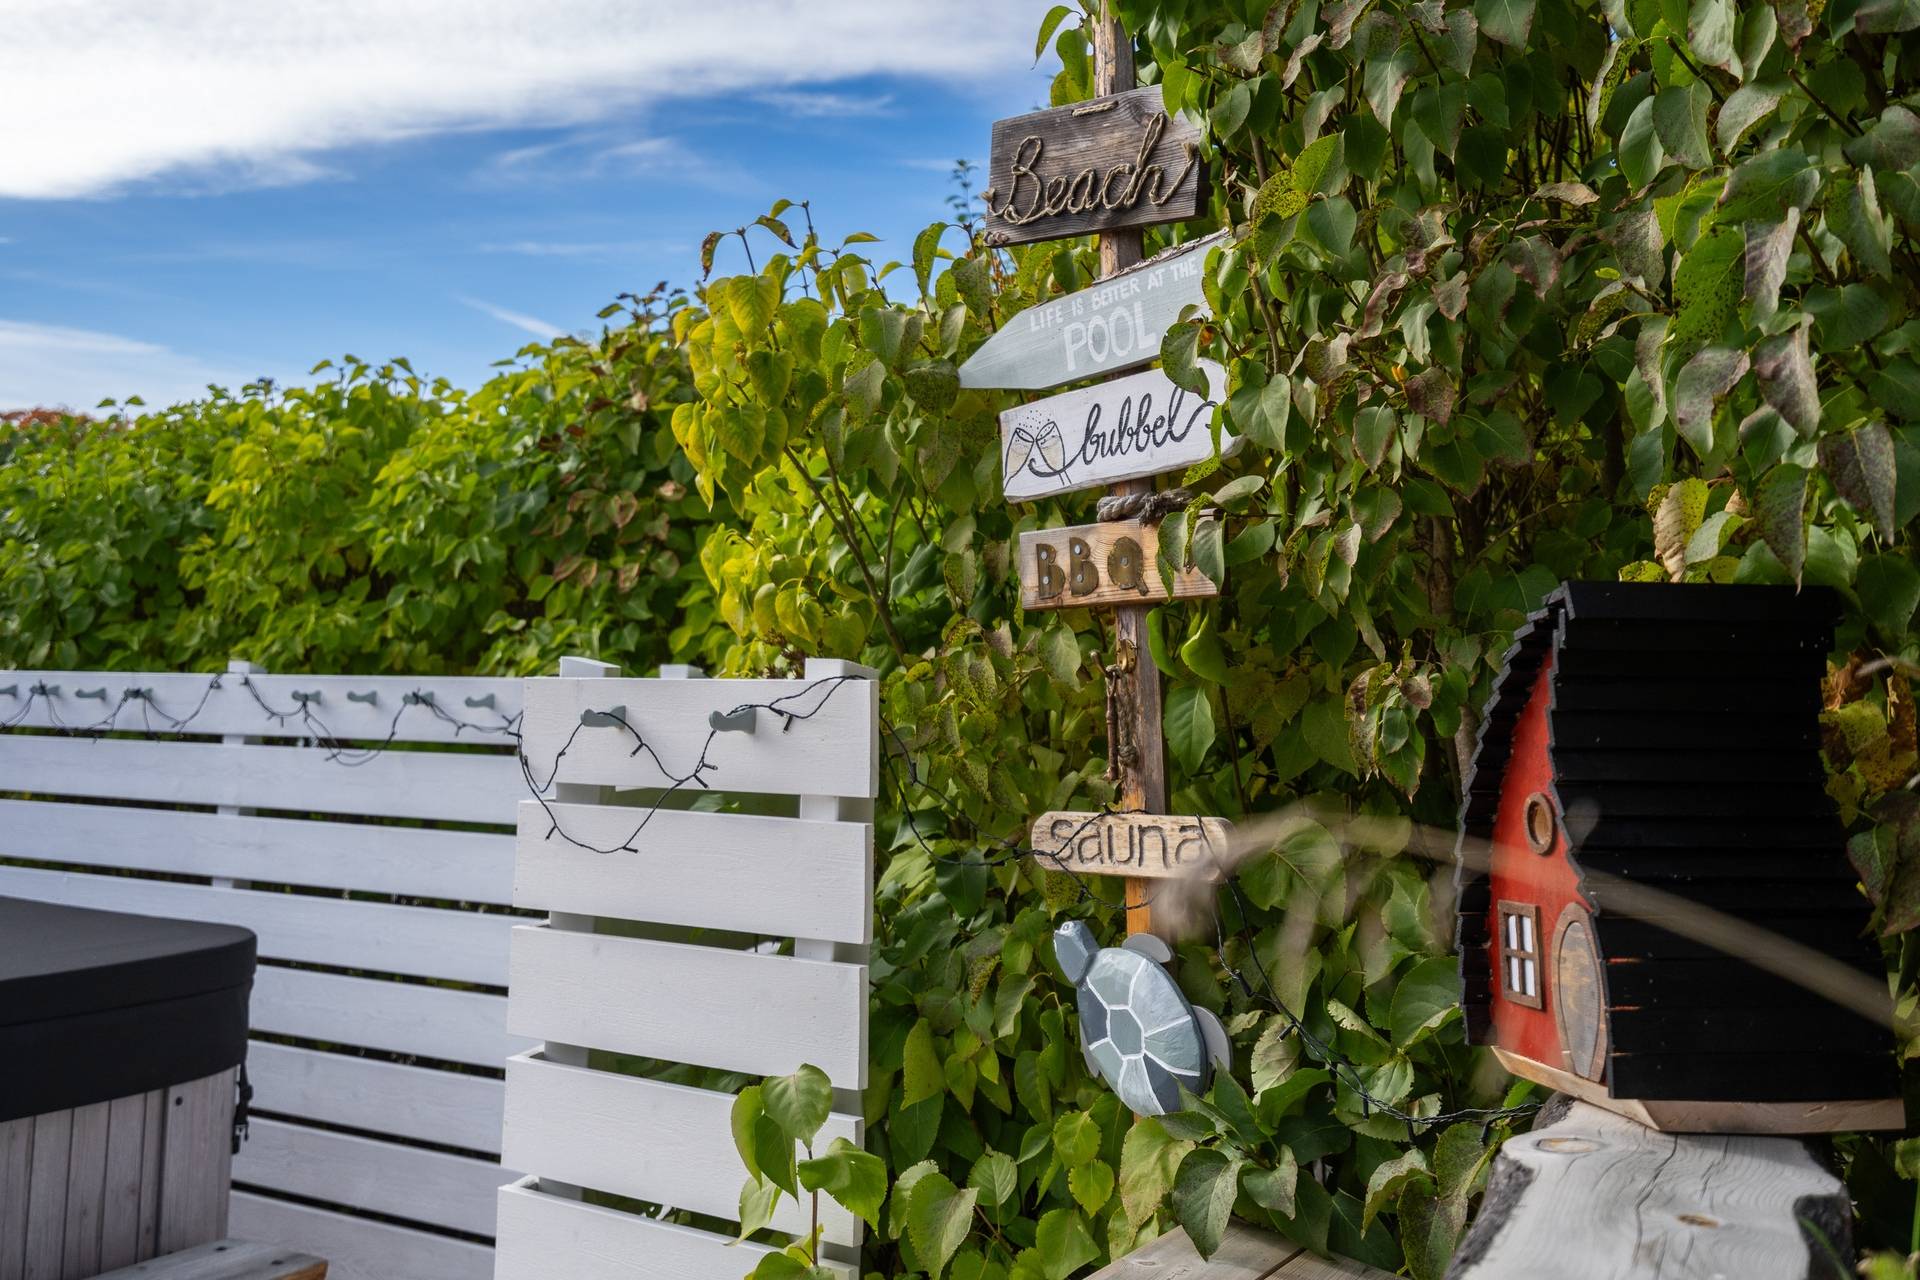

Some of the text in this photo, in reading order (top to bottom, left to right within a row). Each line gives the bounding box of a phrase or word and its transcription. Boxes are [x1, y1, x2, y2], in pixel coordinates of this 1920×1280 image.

[981, 112, 1197, 225] Beach
[1029, 257, 1198, 332] LIFE IS BETTER AT THE
[1063, 300, 1157, 372] POOL
[1036, 536, 1150, 599] BBQ
